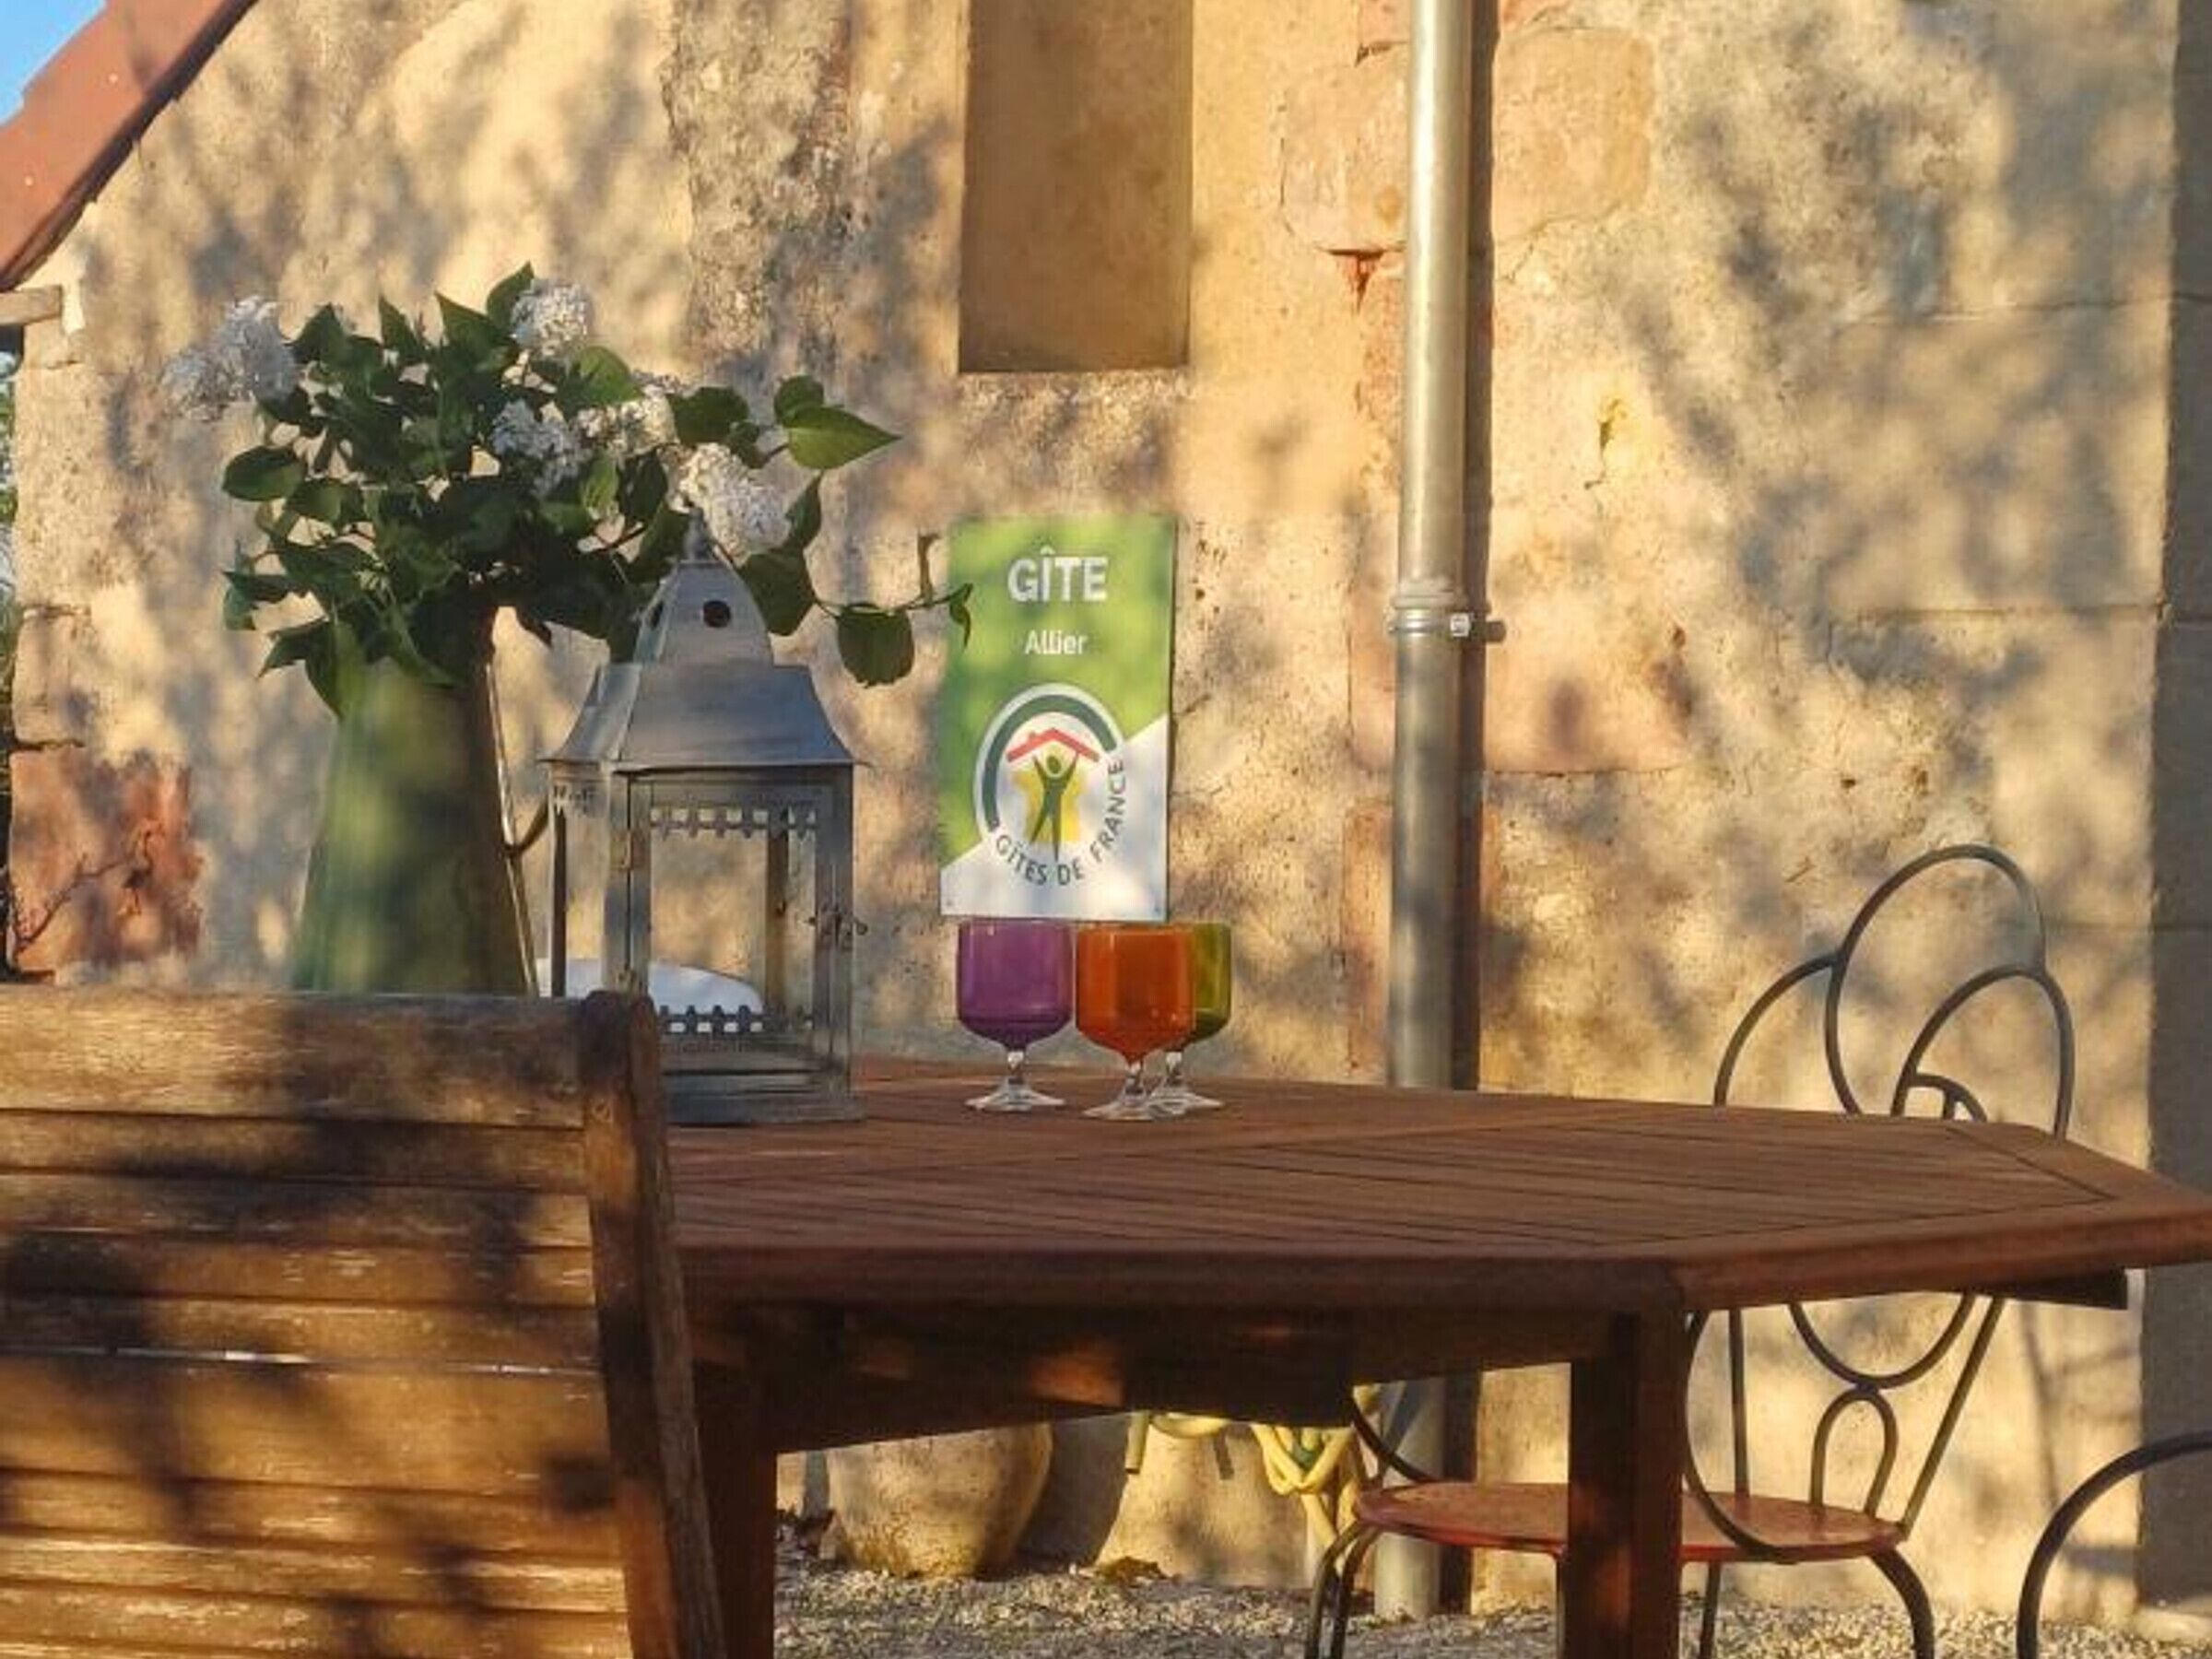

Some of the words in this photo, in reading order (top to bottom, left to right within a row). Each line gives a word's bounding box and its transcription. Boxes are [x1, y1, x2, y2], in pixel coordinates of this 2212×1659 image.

[1007, 546, 1108, 602] GÎTE
[1025, 629, 1088, 655] Allier
[995, 834, 1048, 886] GÎTES
[1057, 857, 1085, 886] DE
[1089, 759, 1126, 863] FRANCE
